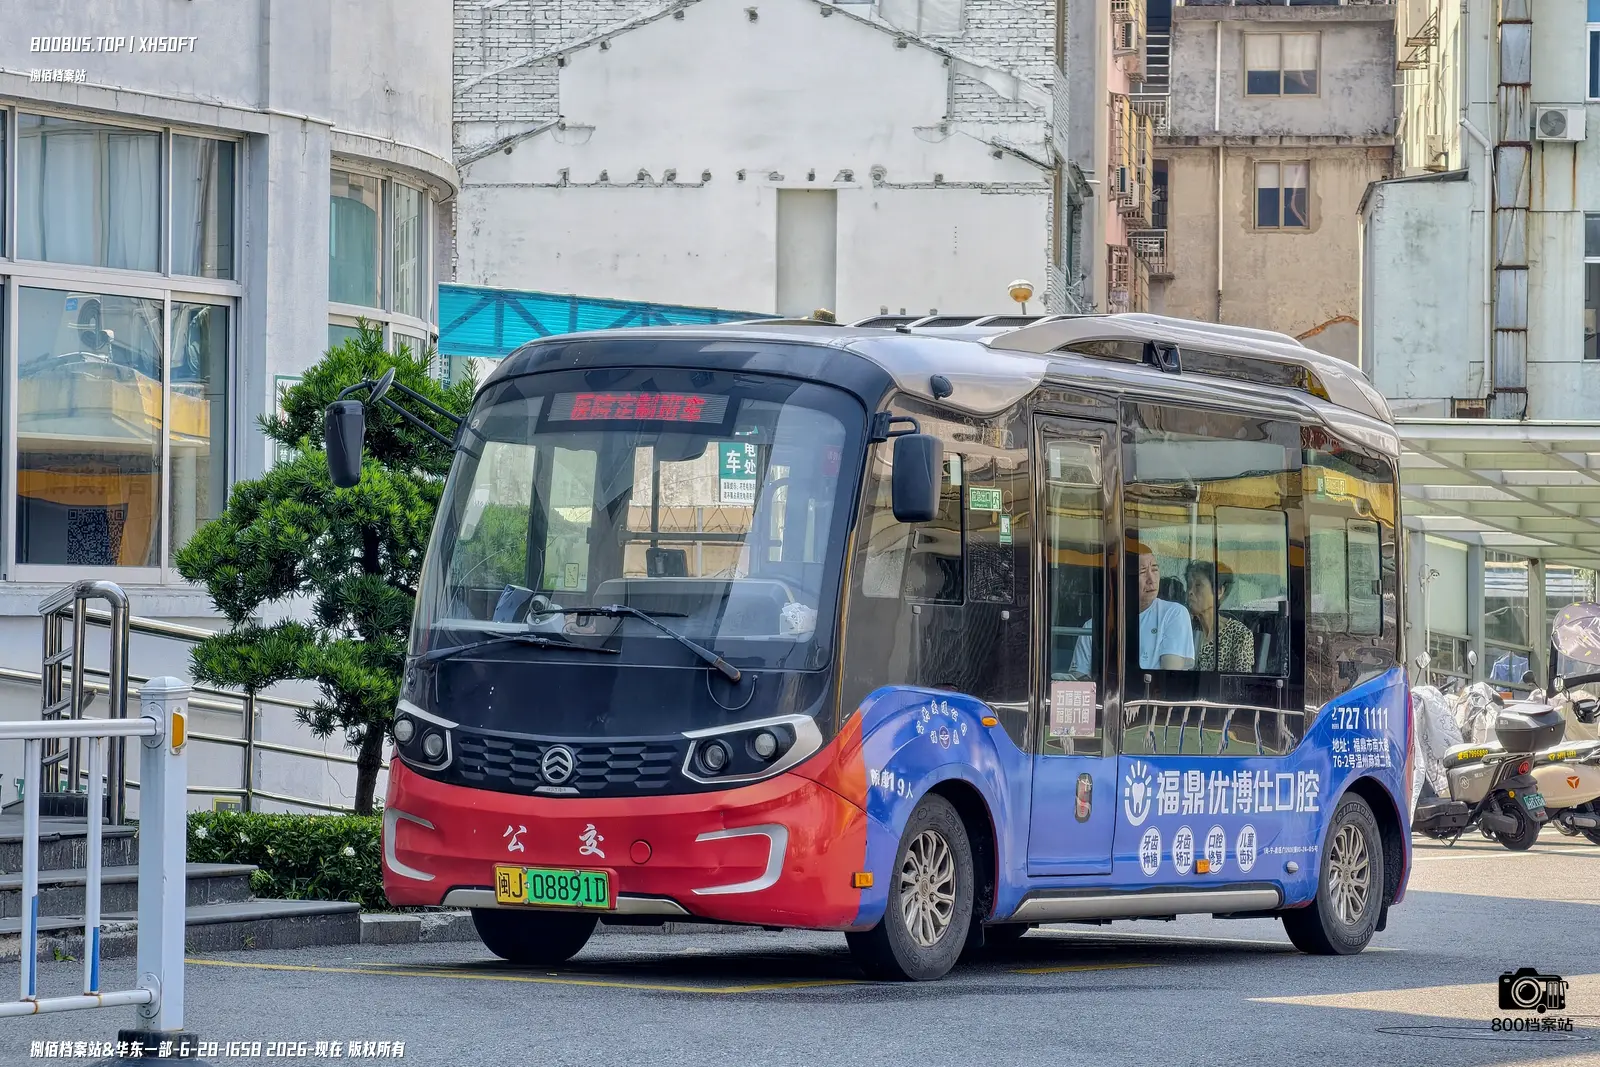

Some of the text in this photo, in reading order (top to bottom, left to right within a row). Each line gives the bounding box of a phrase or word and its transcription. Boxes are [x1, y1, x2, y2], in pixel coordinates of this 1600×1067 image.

[1338, 706, 1388, 730] 727 1111
[1156, 769, 1320, 815] 福鼎优博仕口腔
[503, 823, 606, 859] 公交
[1142, 833, 1159, 851] 牙齿
[1175, 833, 1191, 850] 牙齿
[1208, 832, 1224, 849] 口腔
[1239, 832, 1254, 849] 儿童
[1142, 851, 1159, 868] 种植
[1175, 850, 1191, 867] 矫正
[1208, 850, 1223, 867] 修复
[1239, 849, 1254, 866] 齿科
